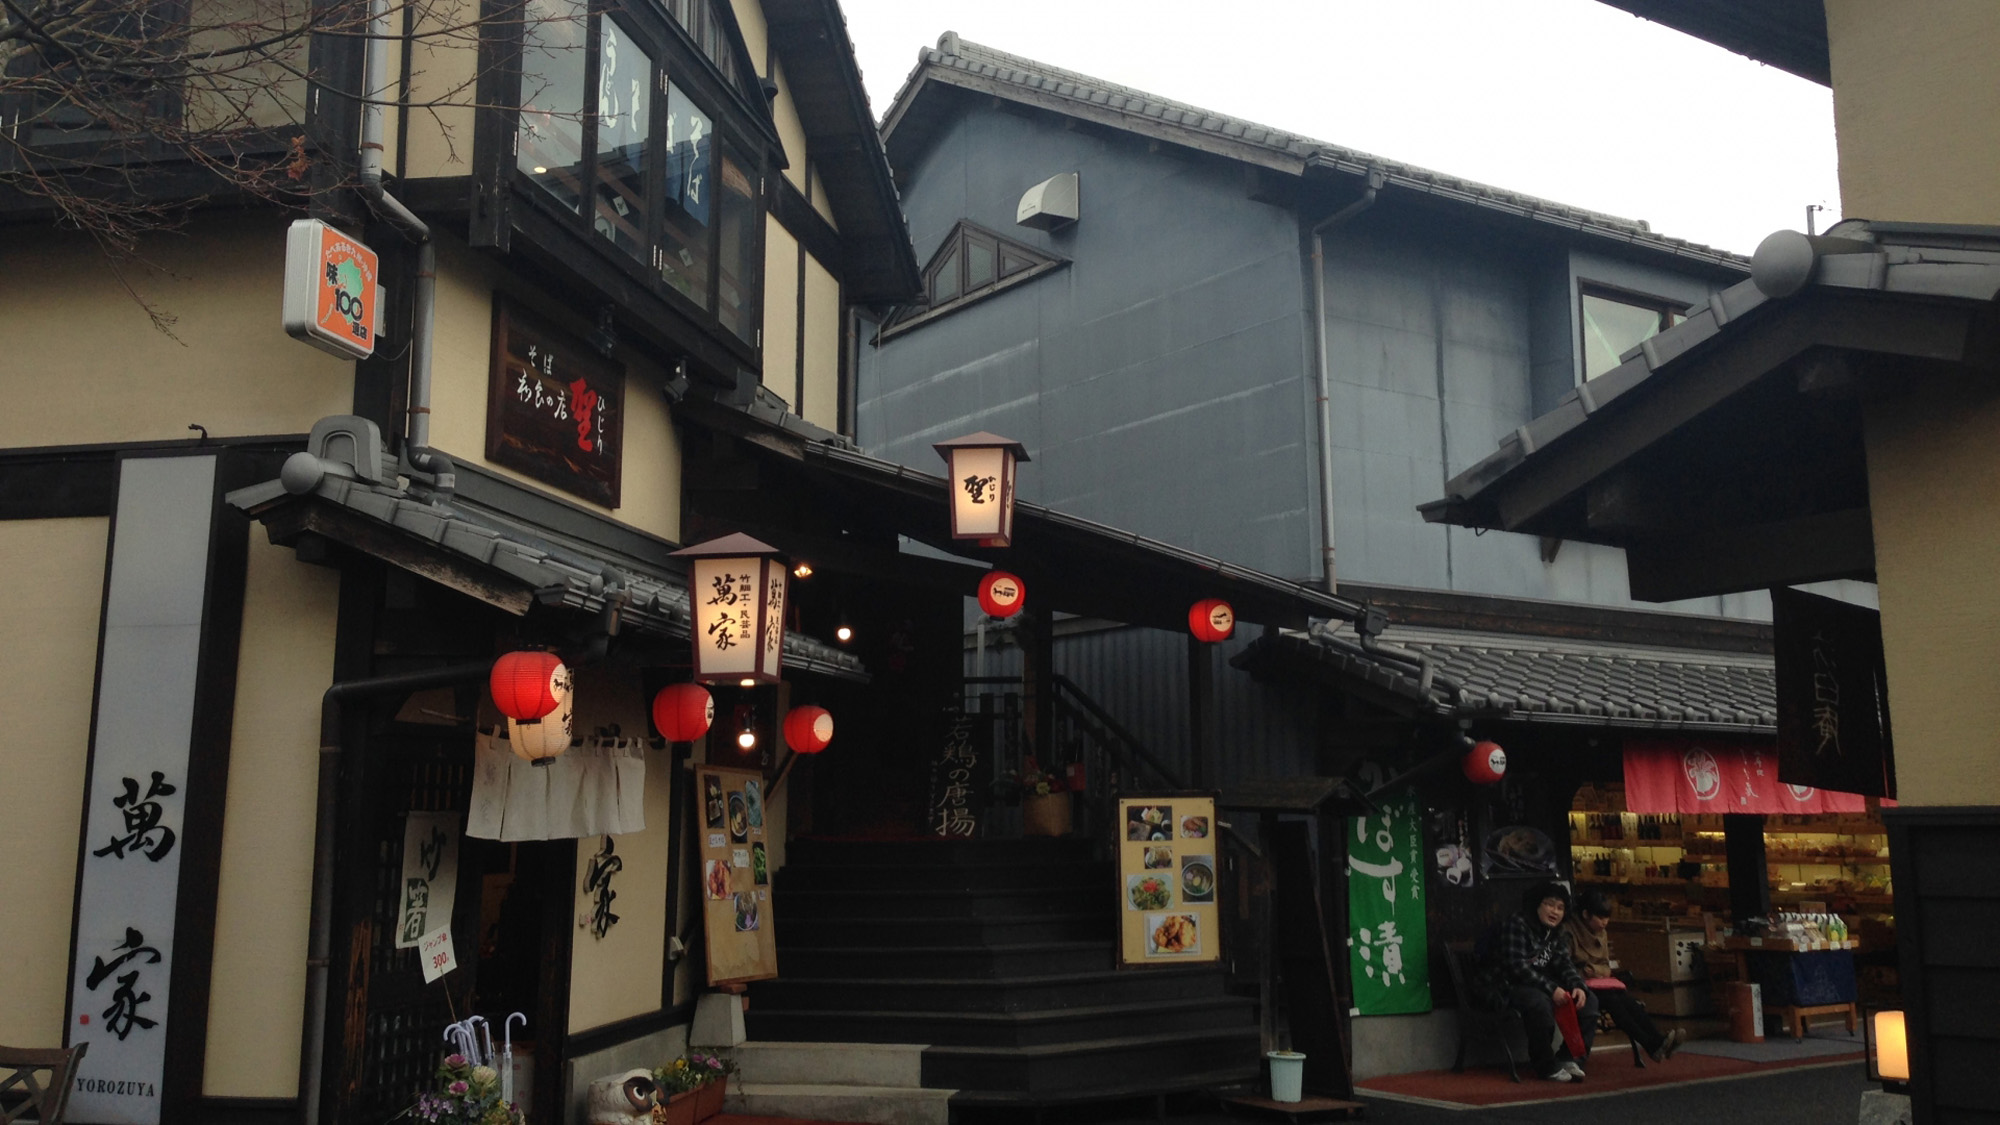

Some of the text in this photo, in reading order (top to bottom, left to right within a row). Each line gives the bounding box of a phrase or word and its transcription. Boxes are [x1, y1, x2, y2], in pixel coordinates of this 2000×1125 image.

[335, 288, 363, 321] 100
[528, 345, 554, 375] そば
[569, 377, 598, 452] 聖
[597, 396, 606, 456] ひじり
[963, 474, 989, 504] 聖
[706, 574, 738, 651] 萬家
[739, 574, 752, 639] 竹細工・民芸品
[86, 771, 176, 1041] 萬家
[77, 1077, 155, 1097] YOROZUYA
